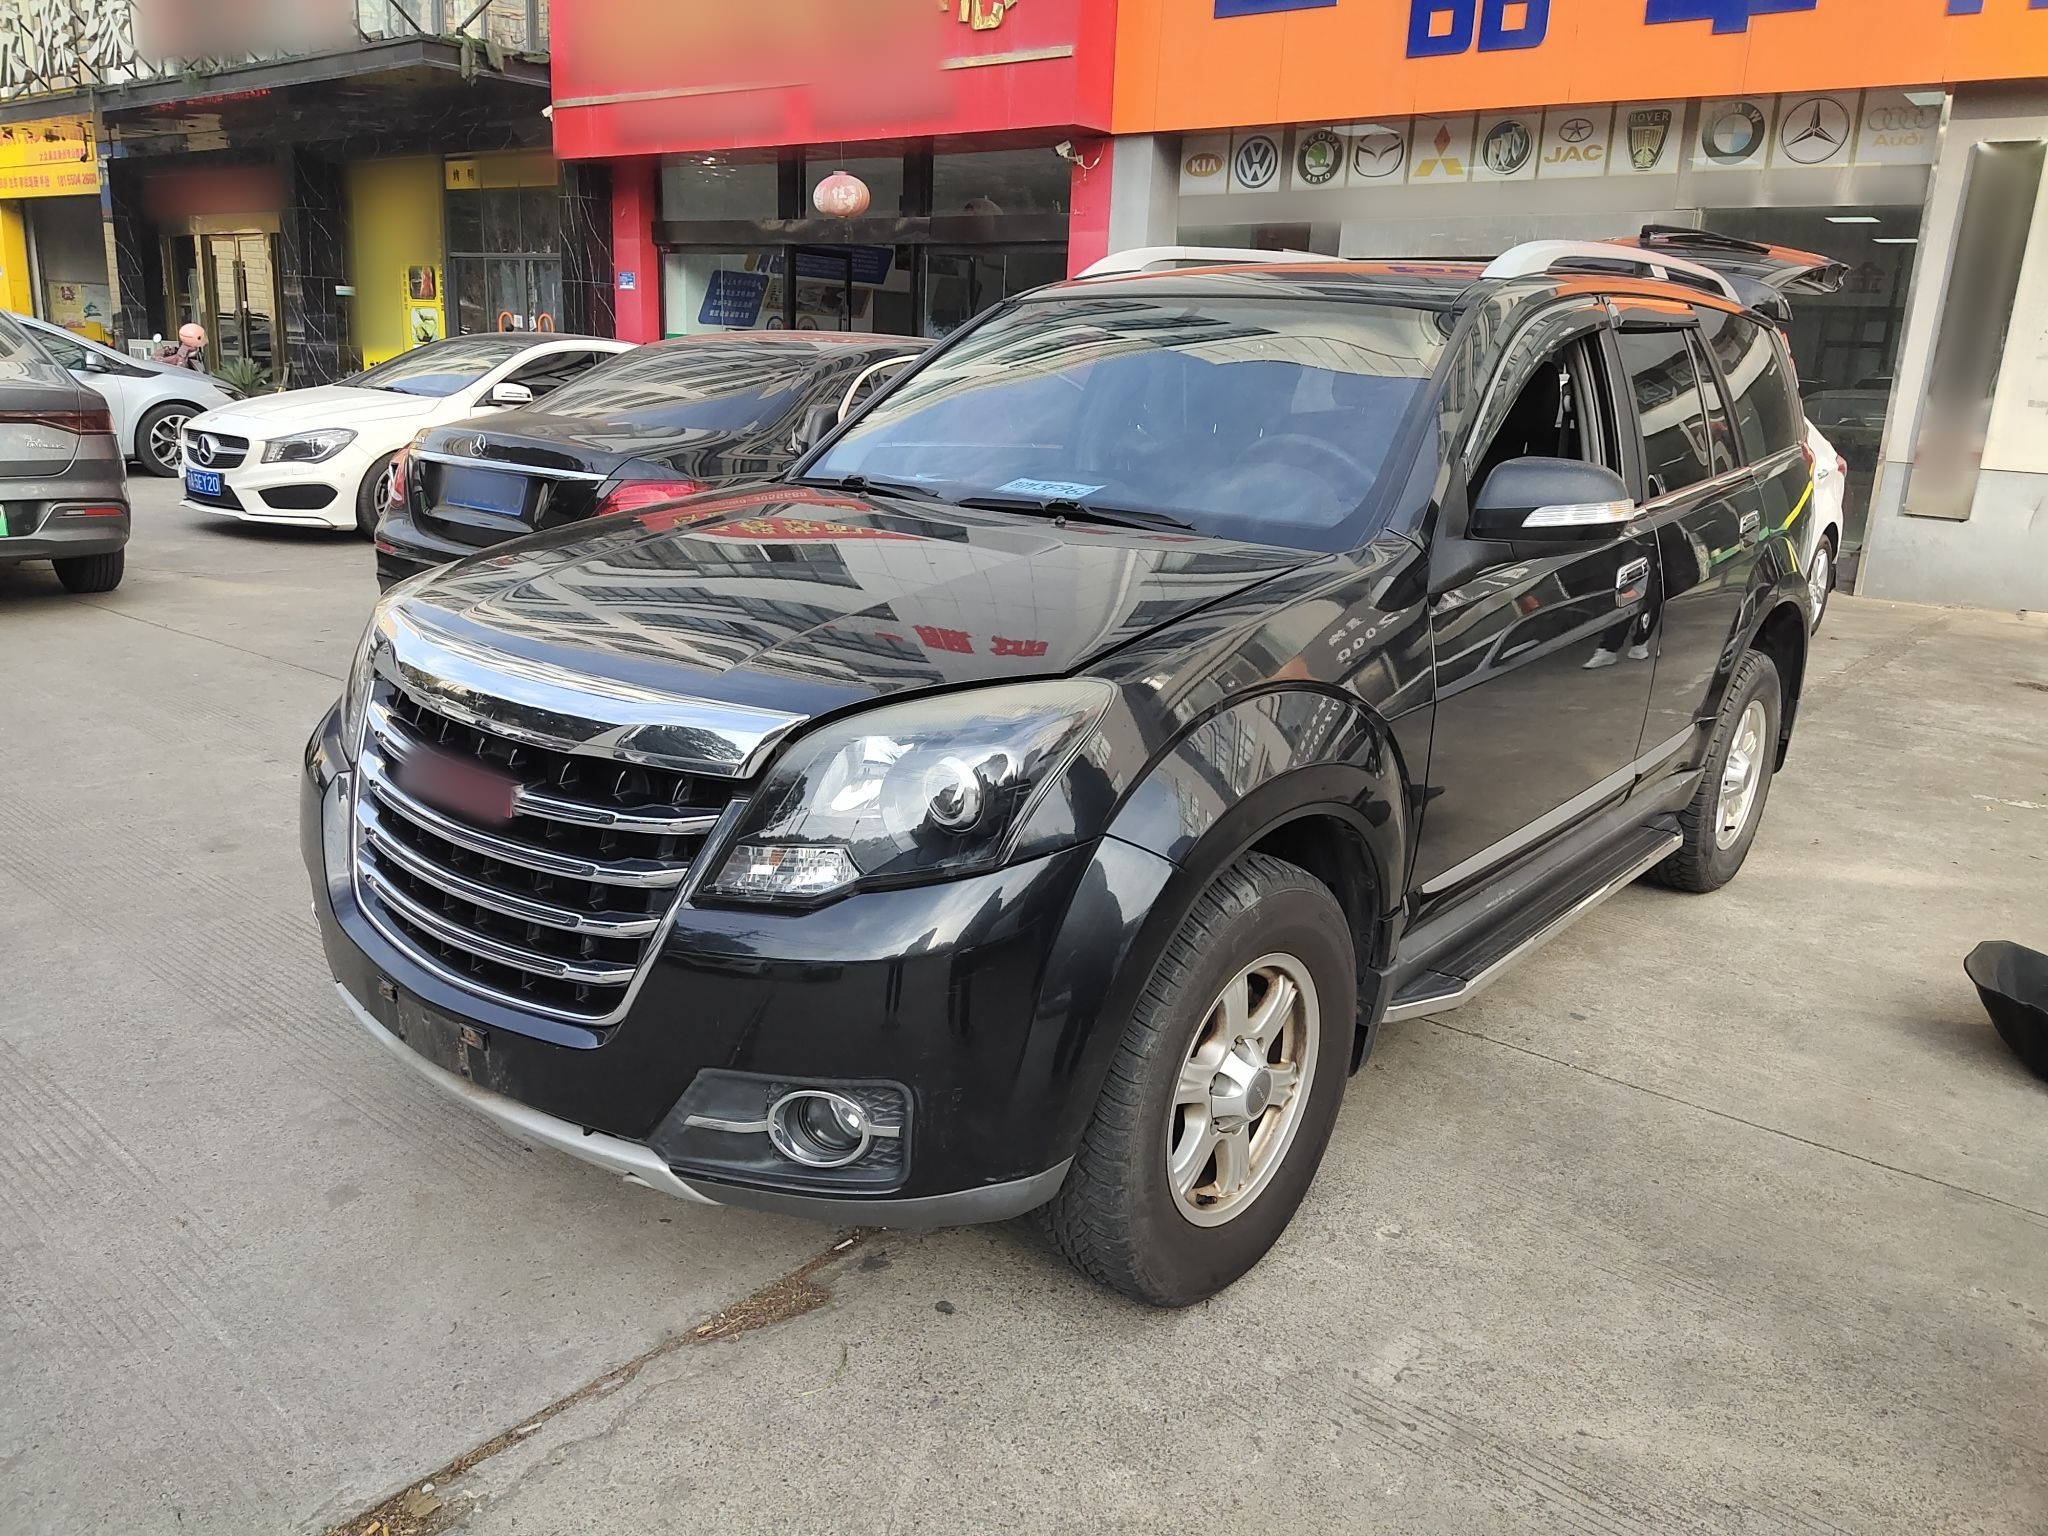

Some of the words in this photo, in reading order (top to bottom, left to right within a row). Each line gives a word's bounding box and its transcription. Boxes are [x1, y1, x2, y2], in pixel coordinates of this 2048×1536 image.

[1630, 111, 1670, 122] ROVER
[1302, 131, 1340, 151] SKODA
[1871, 132, 1924, 147] Audi
[1543, 144, 1604, 164] JAC
[1190, 158, 1217, 172] KIA
[1305, 172, 1331, 183] AUTO
